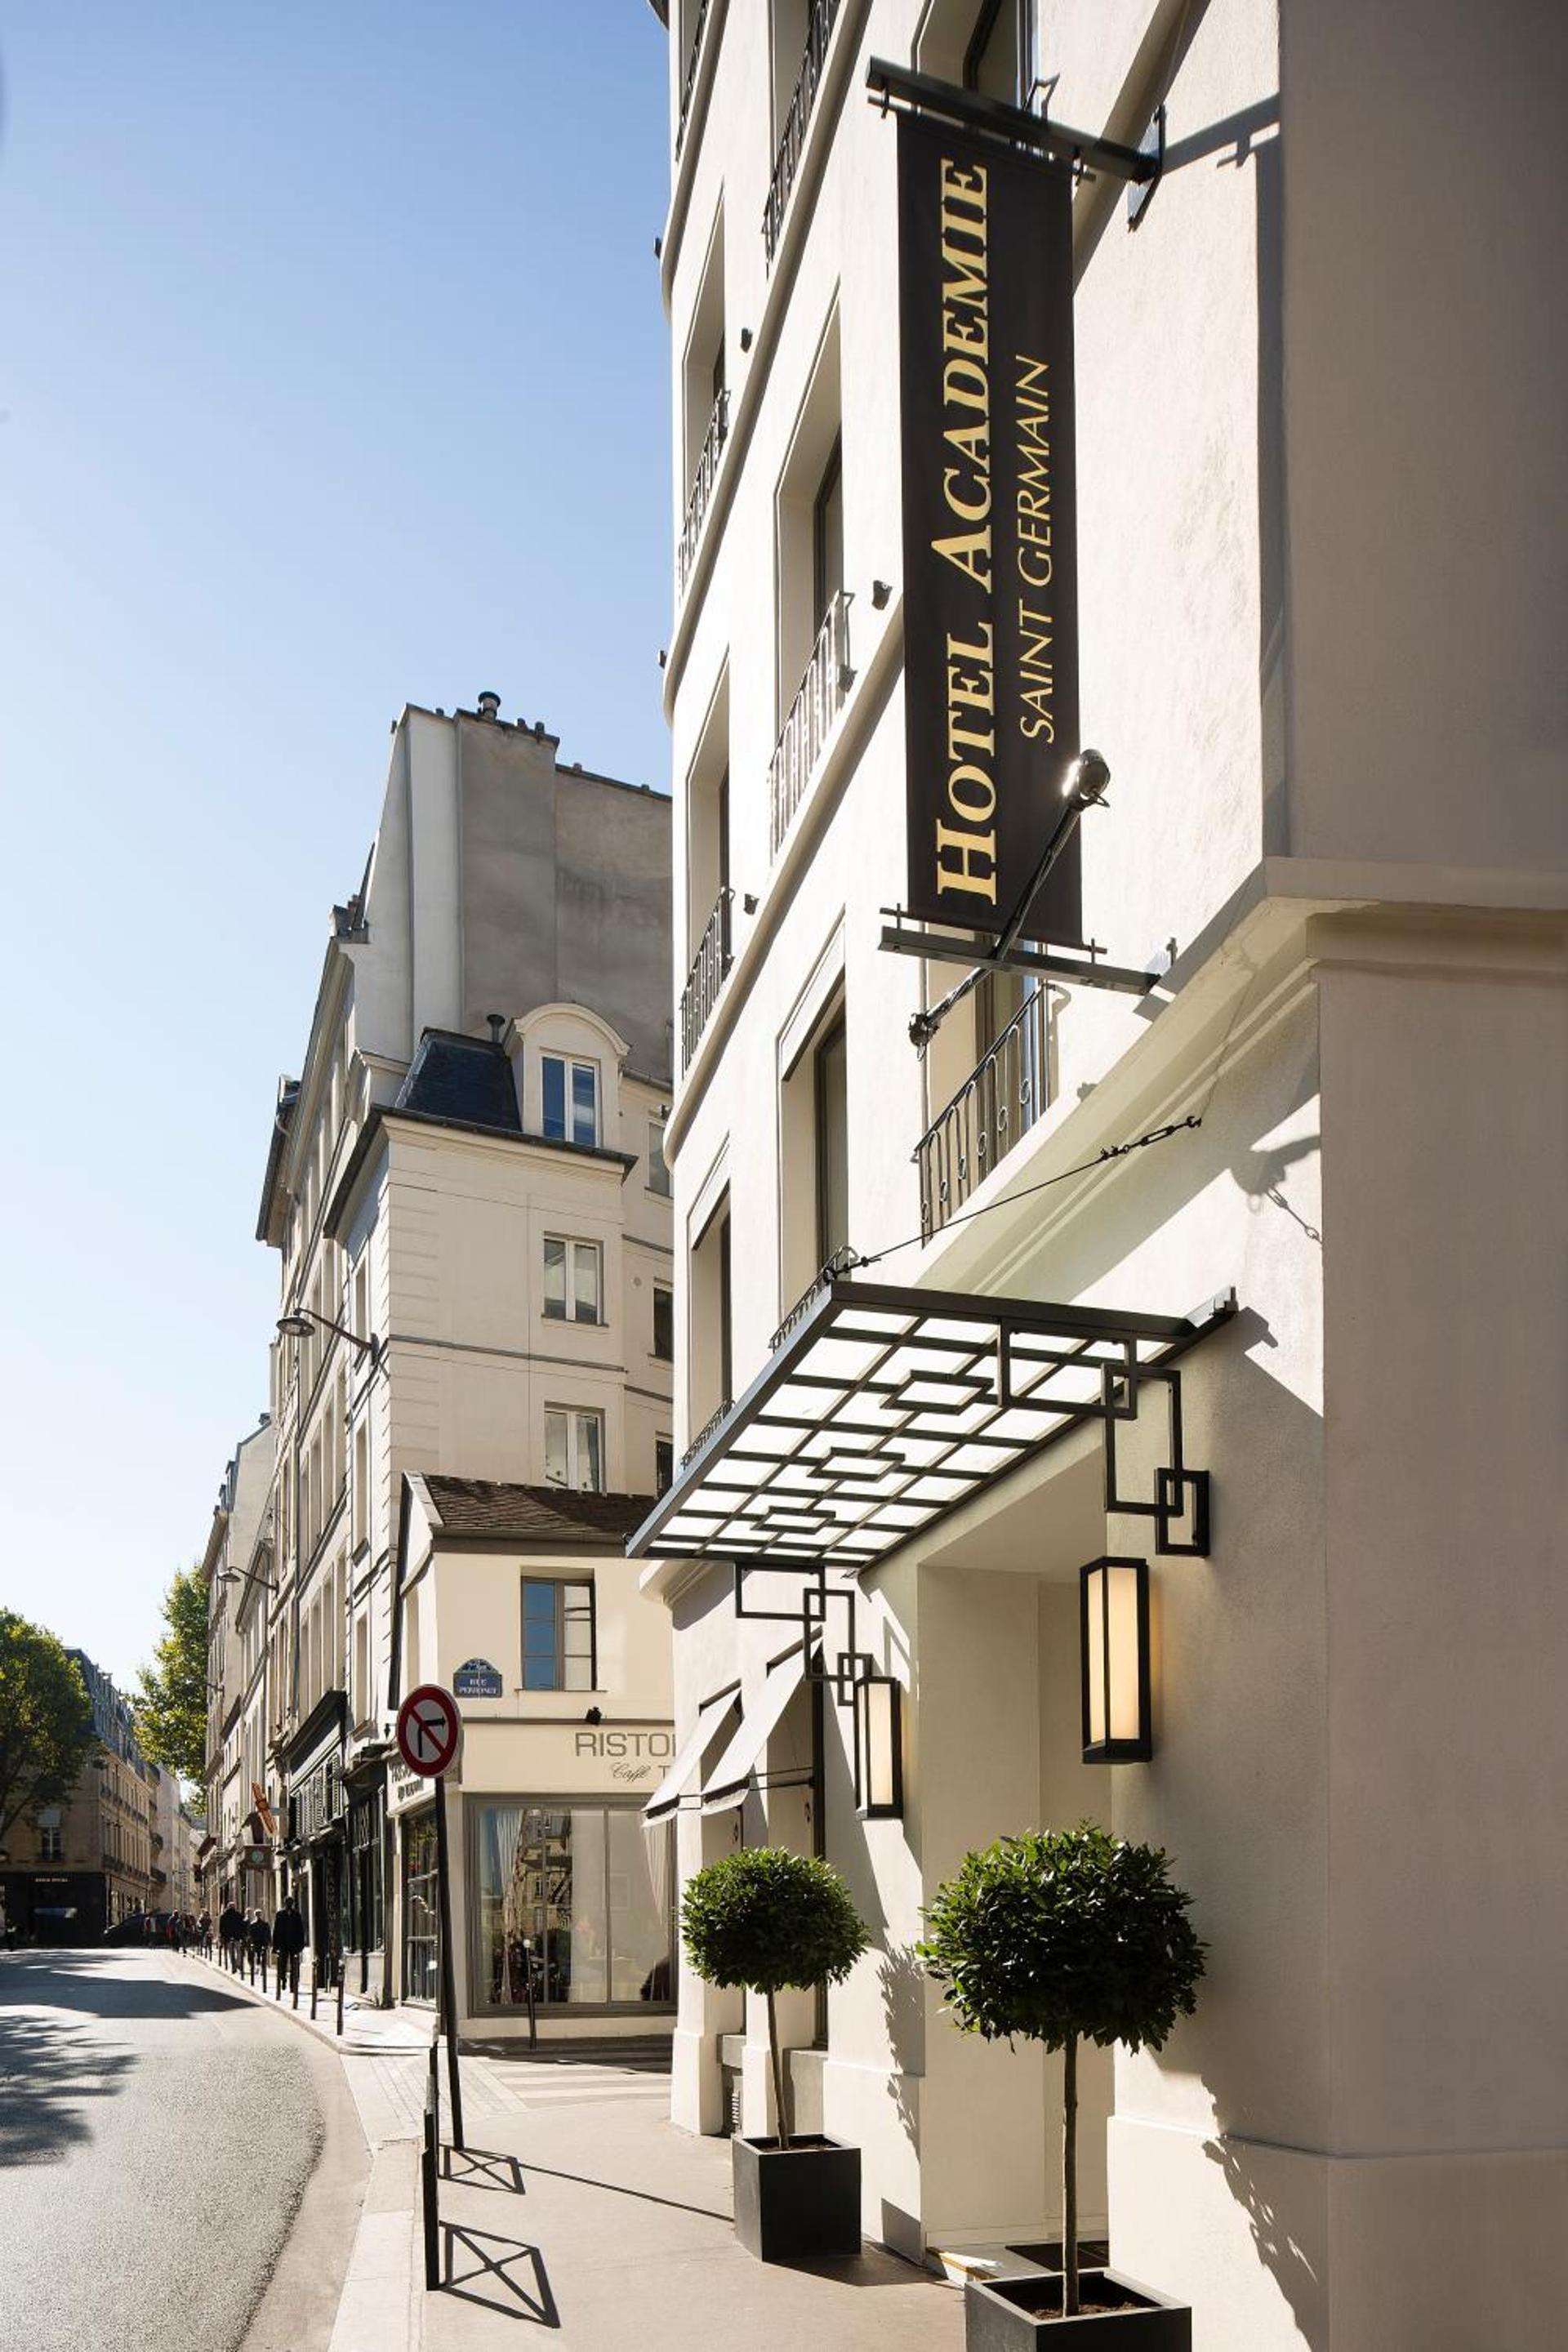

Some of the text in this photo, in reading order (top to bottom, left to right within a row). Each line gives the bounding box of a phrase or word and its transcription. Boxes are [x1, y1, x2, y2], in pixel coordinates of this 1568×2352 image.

[931, 158, 997, 906] HOTEL ACADEMIE
[1014, 354, 1055, 745] SAINT GERMAIN
